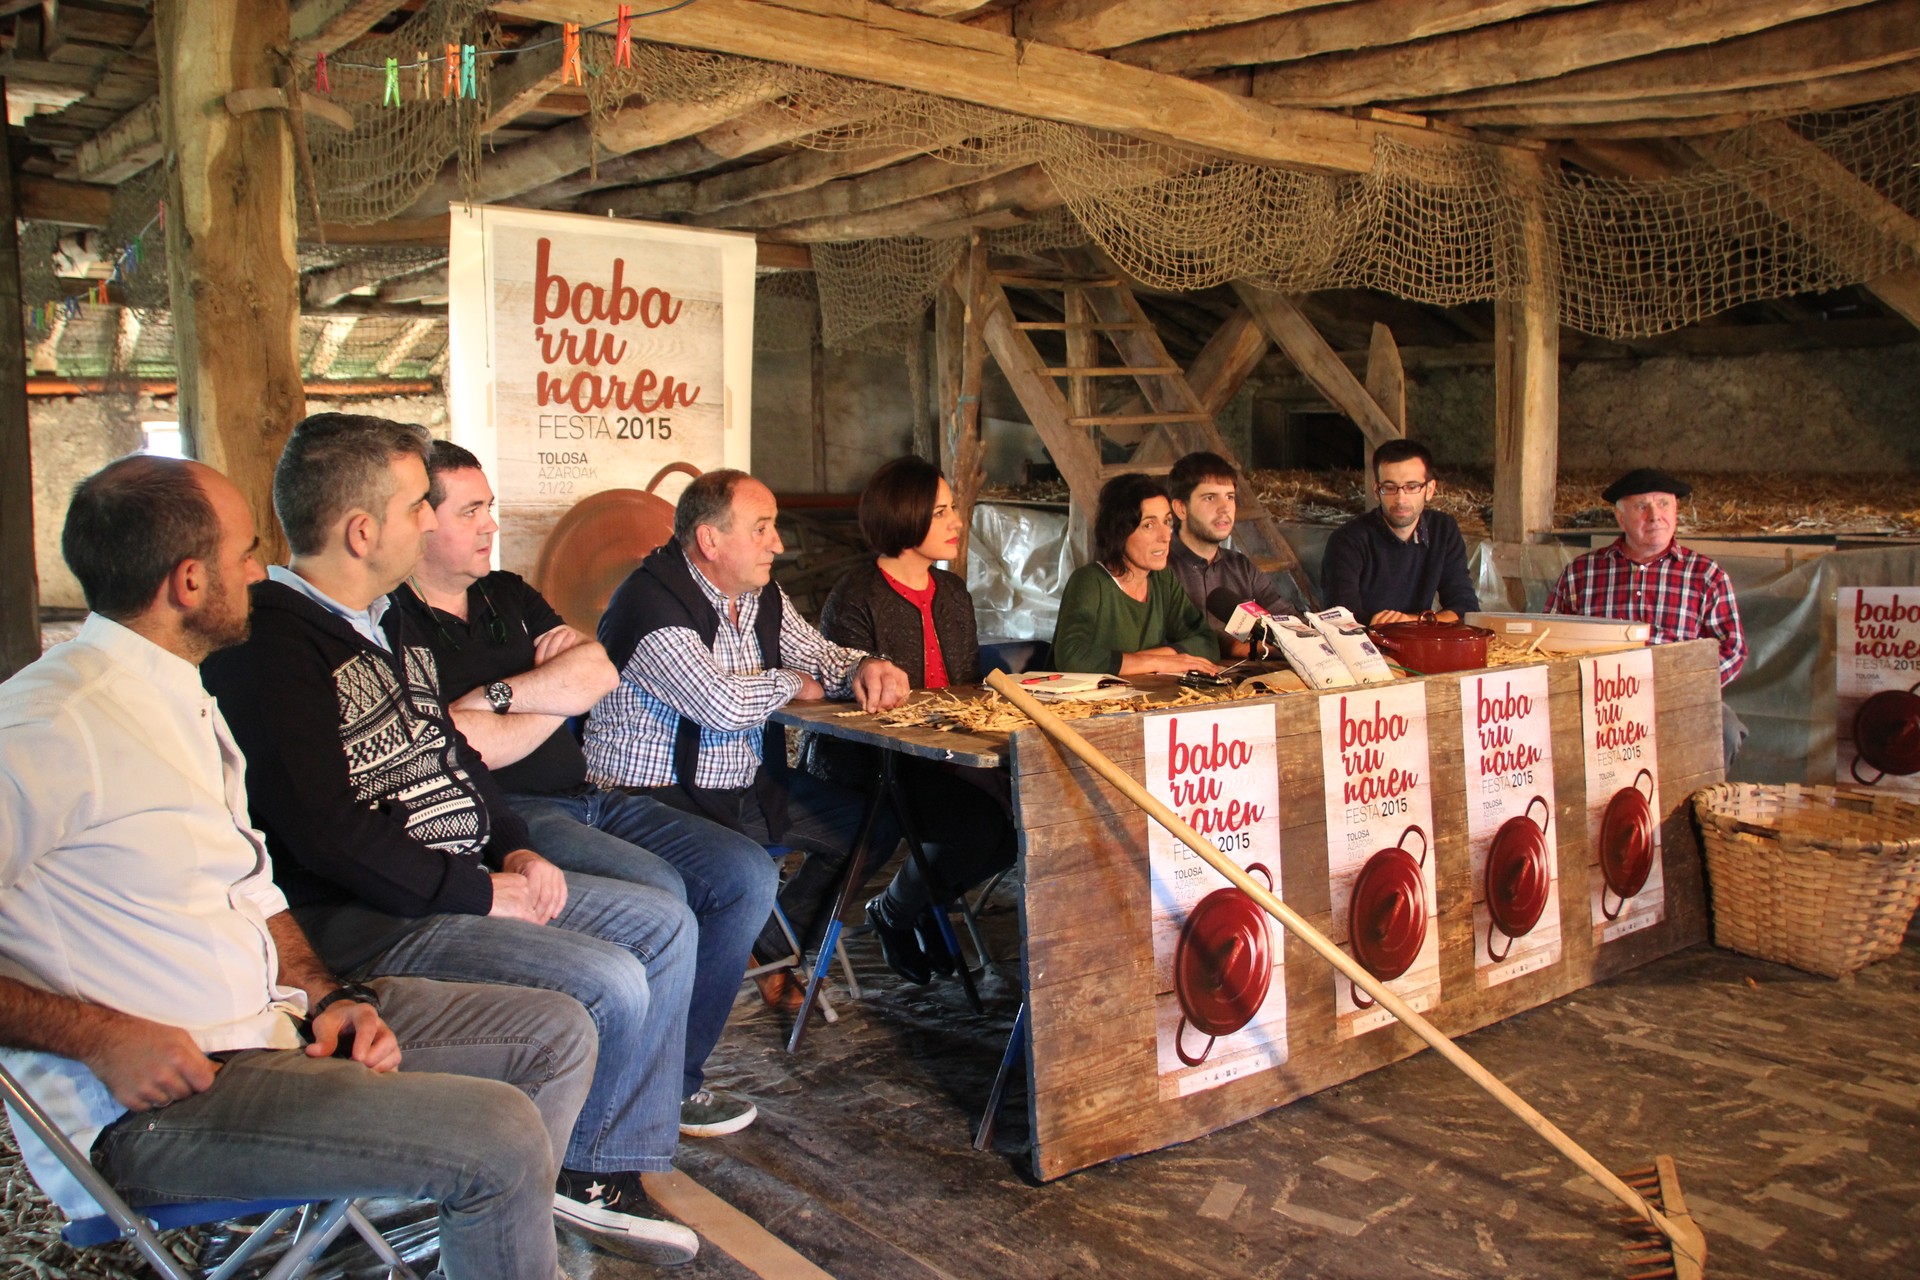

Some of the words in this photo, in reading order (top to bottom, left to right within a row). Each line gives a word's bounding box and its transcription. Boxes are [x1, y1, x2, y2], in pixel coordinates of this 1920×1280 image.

[533, 237, 682, 328] baba
[535, 327, 627, 366] rru
[536, 369, 701, 414] naren
[538, 414, 612, 440] FESTA
[615, 416, 672, 441] 2015
[537, 451, 588, 465] TOLOSA
[537, 466, 598, 479] AZAROAK
[538, 481, 574, 494] 21/22
[1855, 623, 1900, 639] rru
[1855, 639, 1920, 659] nare
[1855, 658, 1891, 670] FESTA
[1593, 660, 1640, 707] baba
[1477, 677, 1533, 729] baba
[1595, 703, 1623, 726] rru
[1339, 696, 1409, 753] baba
[1478, 725, 1513, 750] rru
[1596, 720, 1648, 750] naren
[1168, 717, 1253, 781] baba
[1341, 748, 1384, 777] rru
[1480, 743, 1542, 776] naren
[1597, 749, 1622, 767] FESTA
[1622, 745, 1641, 761] 2015
[1170, 776, 1223, 807] rru
[1343, 767, 1418, 804] naren
[1482, 776, 1511, 795] FESTA
[1512, 770, 1533, 788] 2015
[1345, 803, 1380, 826] FESTA
[1381, 797, 1408, 817] 2015
[1482, 799, 1502, 810] TOLOSA
[1172, 799, 1265, 838] aren
[1217, 832, 1250, 853] 2015
[1346, 829, 1370, 841] TOLOSA
[1174, 866, 1203, 880] TOLOSA
